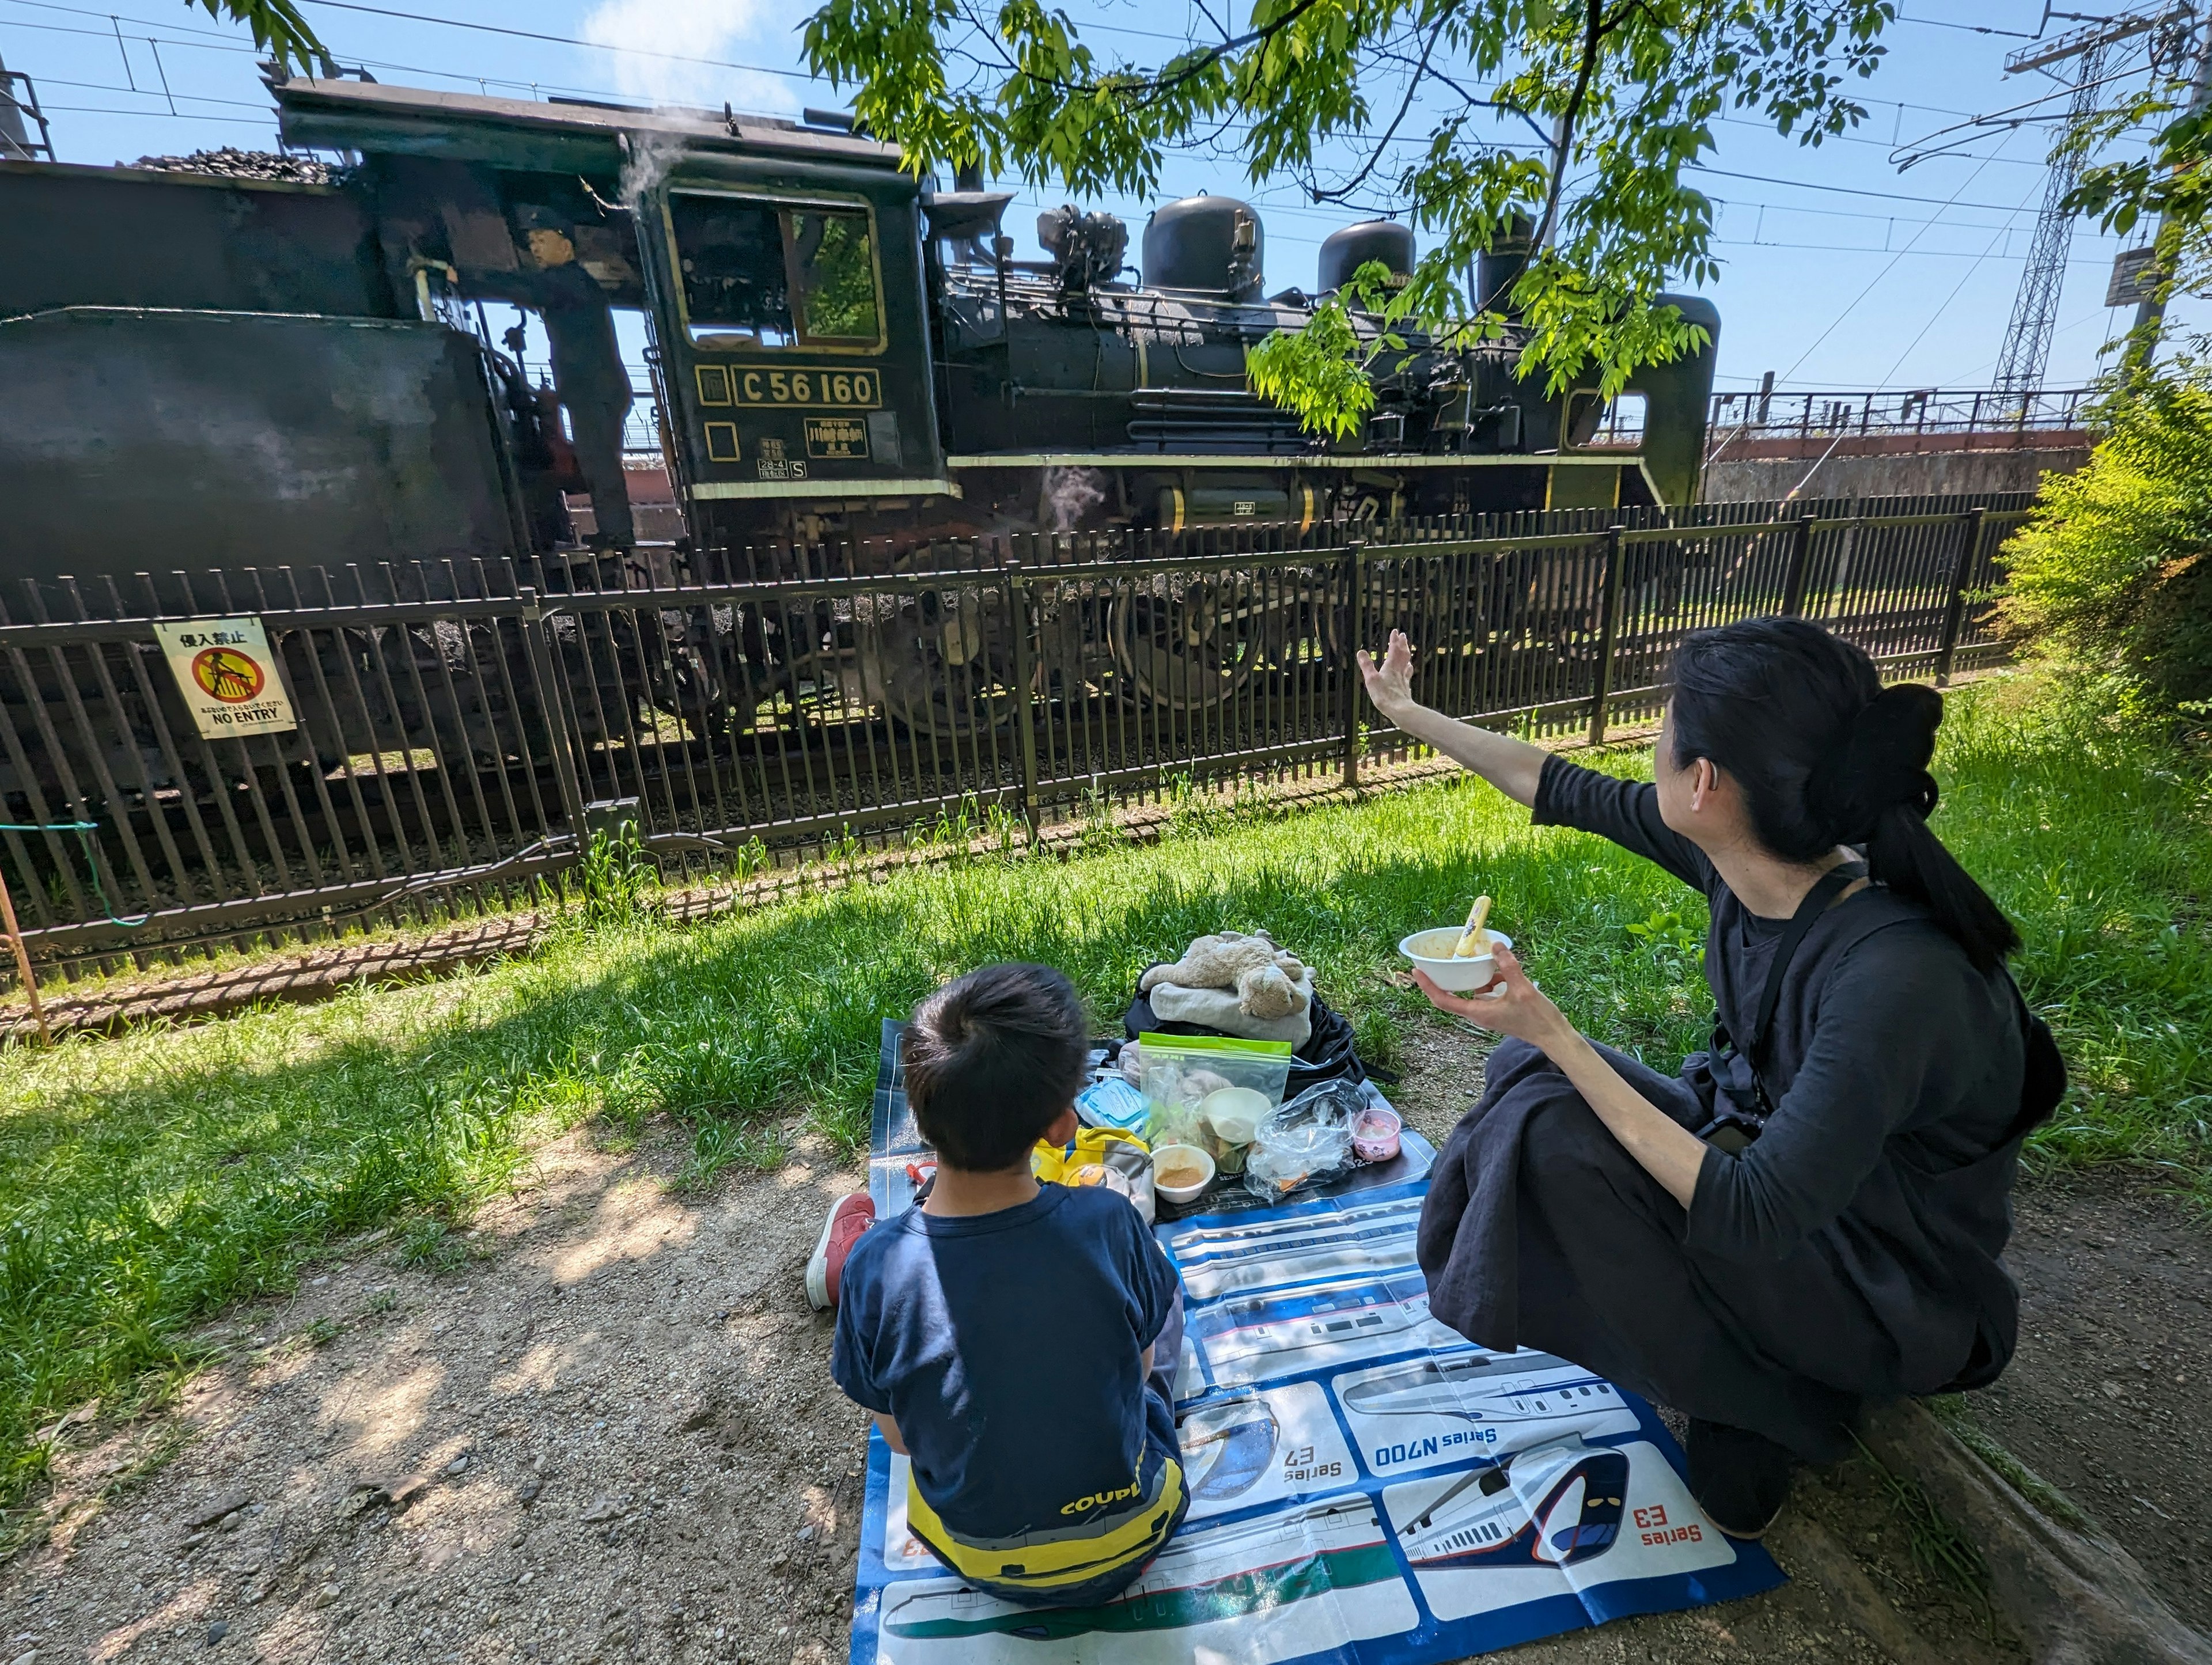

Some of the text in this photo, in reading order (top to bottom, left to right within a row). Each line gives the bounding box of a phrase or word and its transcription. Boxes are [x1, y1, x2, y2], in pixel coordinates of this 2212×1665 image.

[820, 374, 872, 403] 160
[793, 462, 804, 477] S
[180, 630, 248, 648] 侵入禁止
[212, 713, 233, 725] NO
[234, 707, 278, 723] ENTRY
[1284, 1446, 1314, 1467] E7
[1375, 1428, 1498, 1467] Series N700
[1283, 1461, 1342, 1483] Series
[1633, 1504, 1668, 1529] E3
[1641, 1524, 1703, 1546] Series
